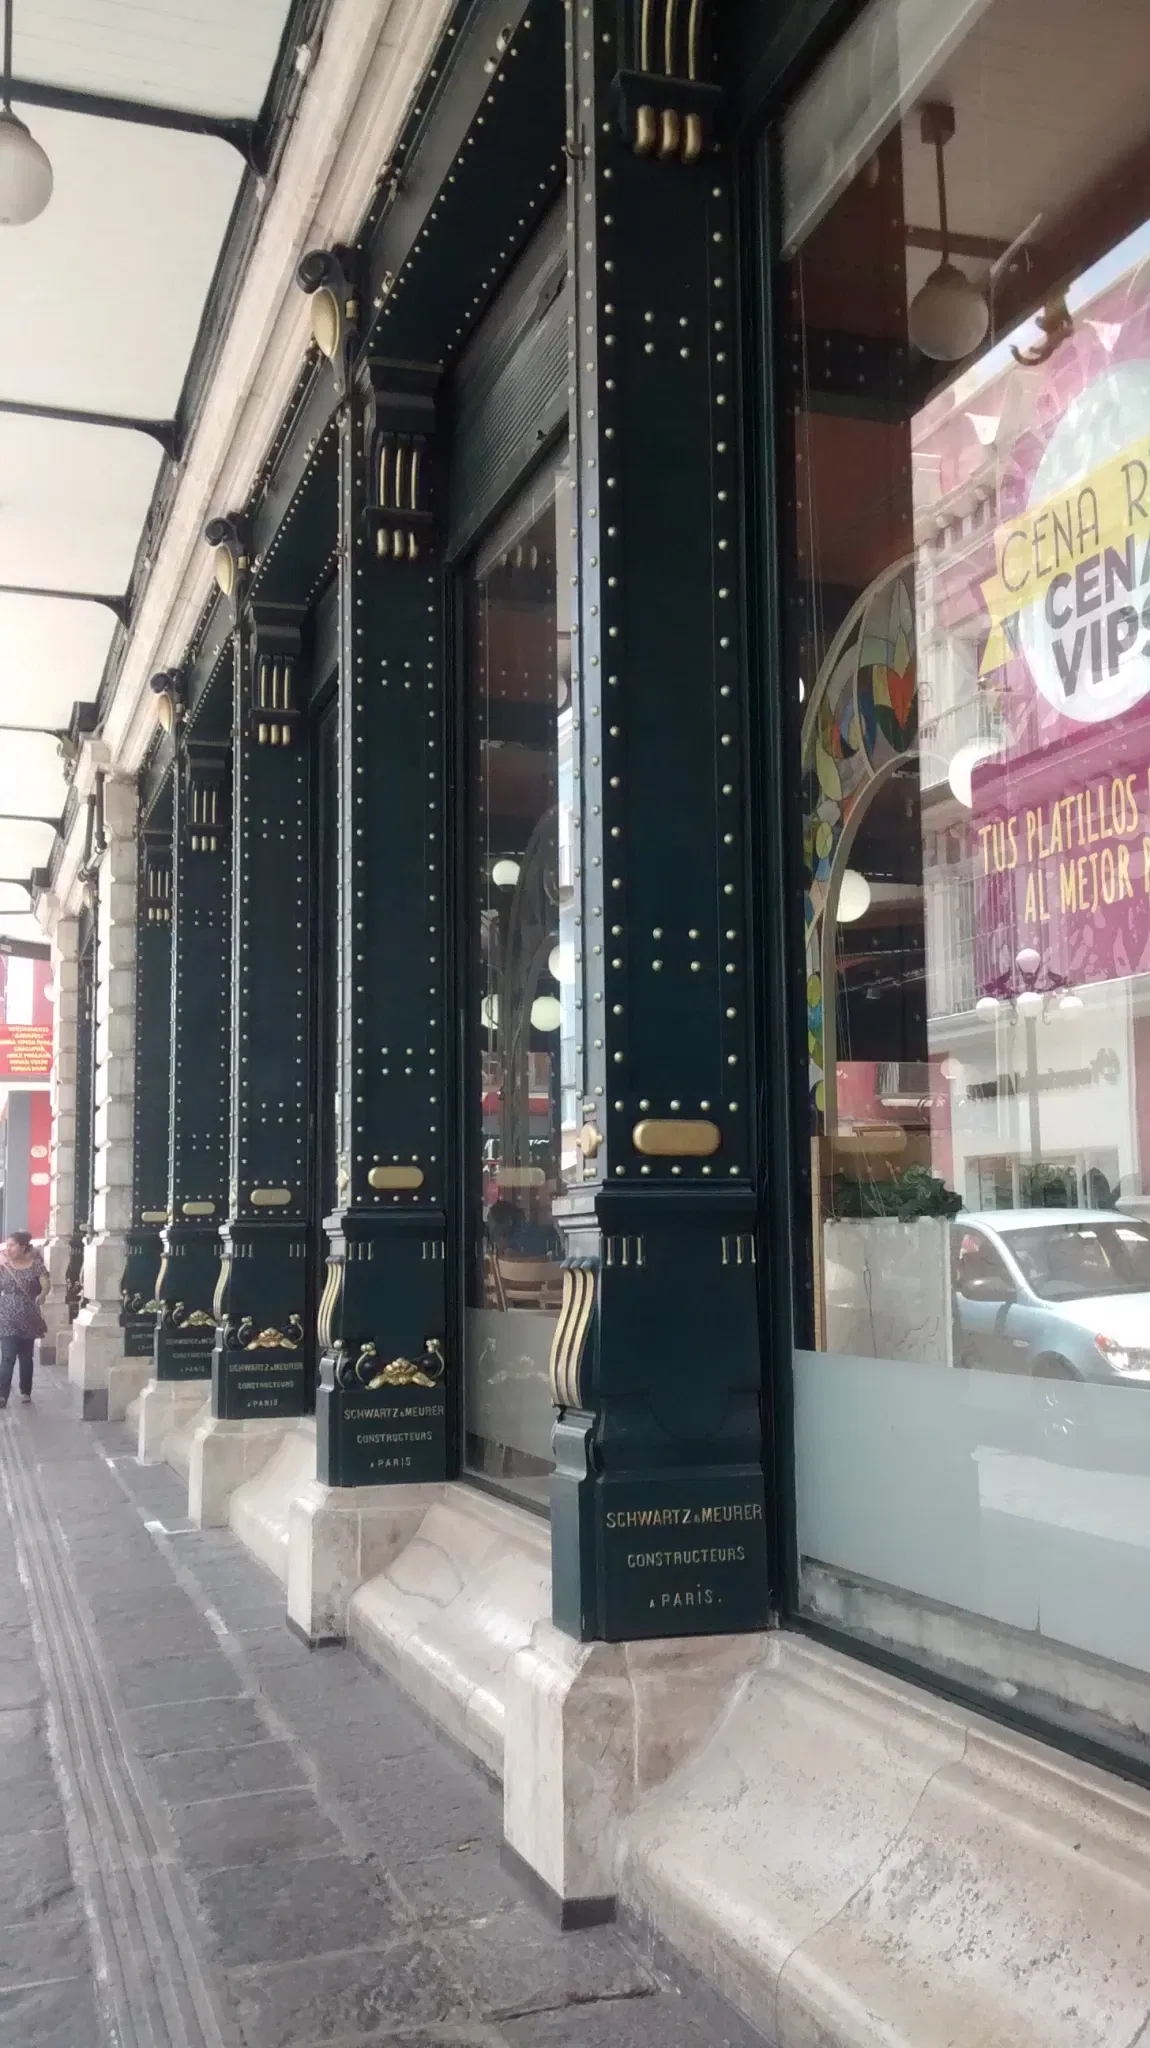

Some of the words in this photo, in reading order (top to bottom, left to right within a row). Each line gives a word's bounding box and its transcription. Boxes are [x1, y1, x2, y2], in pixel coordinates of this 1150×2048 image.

[1001, 486, 1099, 593] CENA
[1120, 458, 1150, 527] R
[978, 816, 1018, 874] TUS
[1026, 774, 1139, 862] PLATILLOS
[1024, 868, 1050, 924] AL
[1060, 844, 1133, 914] MEJOR
[344, 1407, 399, 1420] SCHWARTZ
[404, 1405, 445, 1417] MEURER
[356, 1430, 433, 1444] CONSTRUCTEURS
[378, 1457, 411, 1468] PARIS
[606, 1508, 691, 1528] SCHWARTZ
[702, 1504, 763, 1523] MEURER
[628, 1546, 745, 1568] CONSTRUCTEURS
